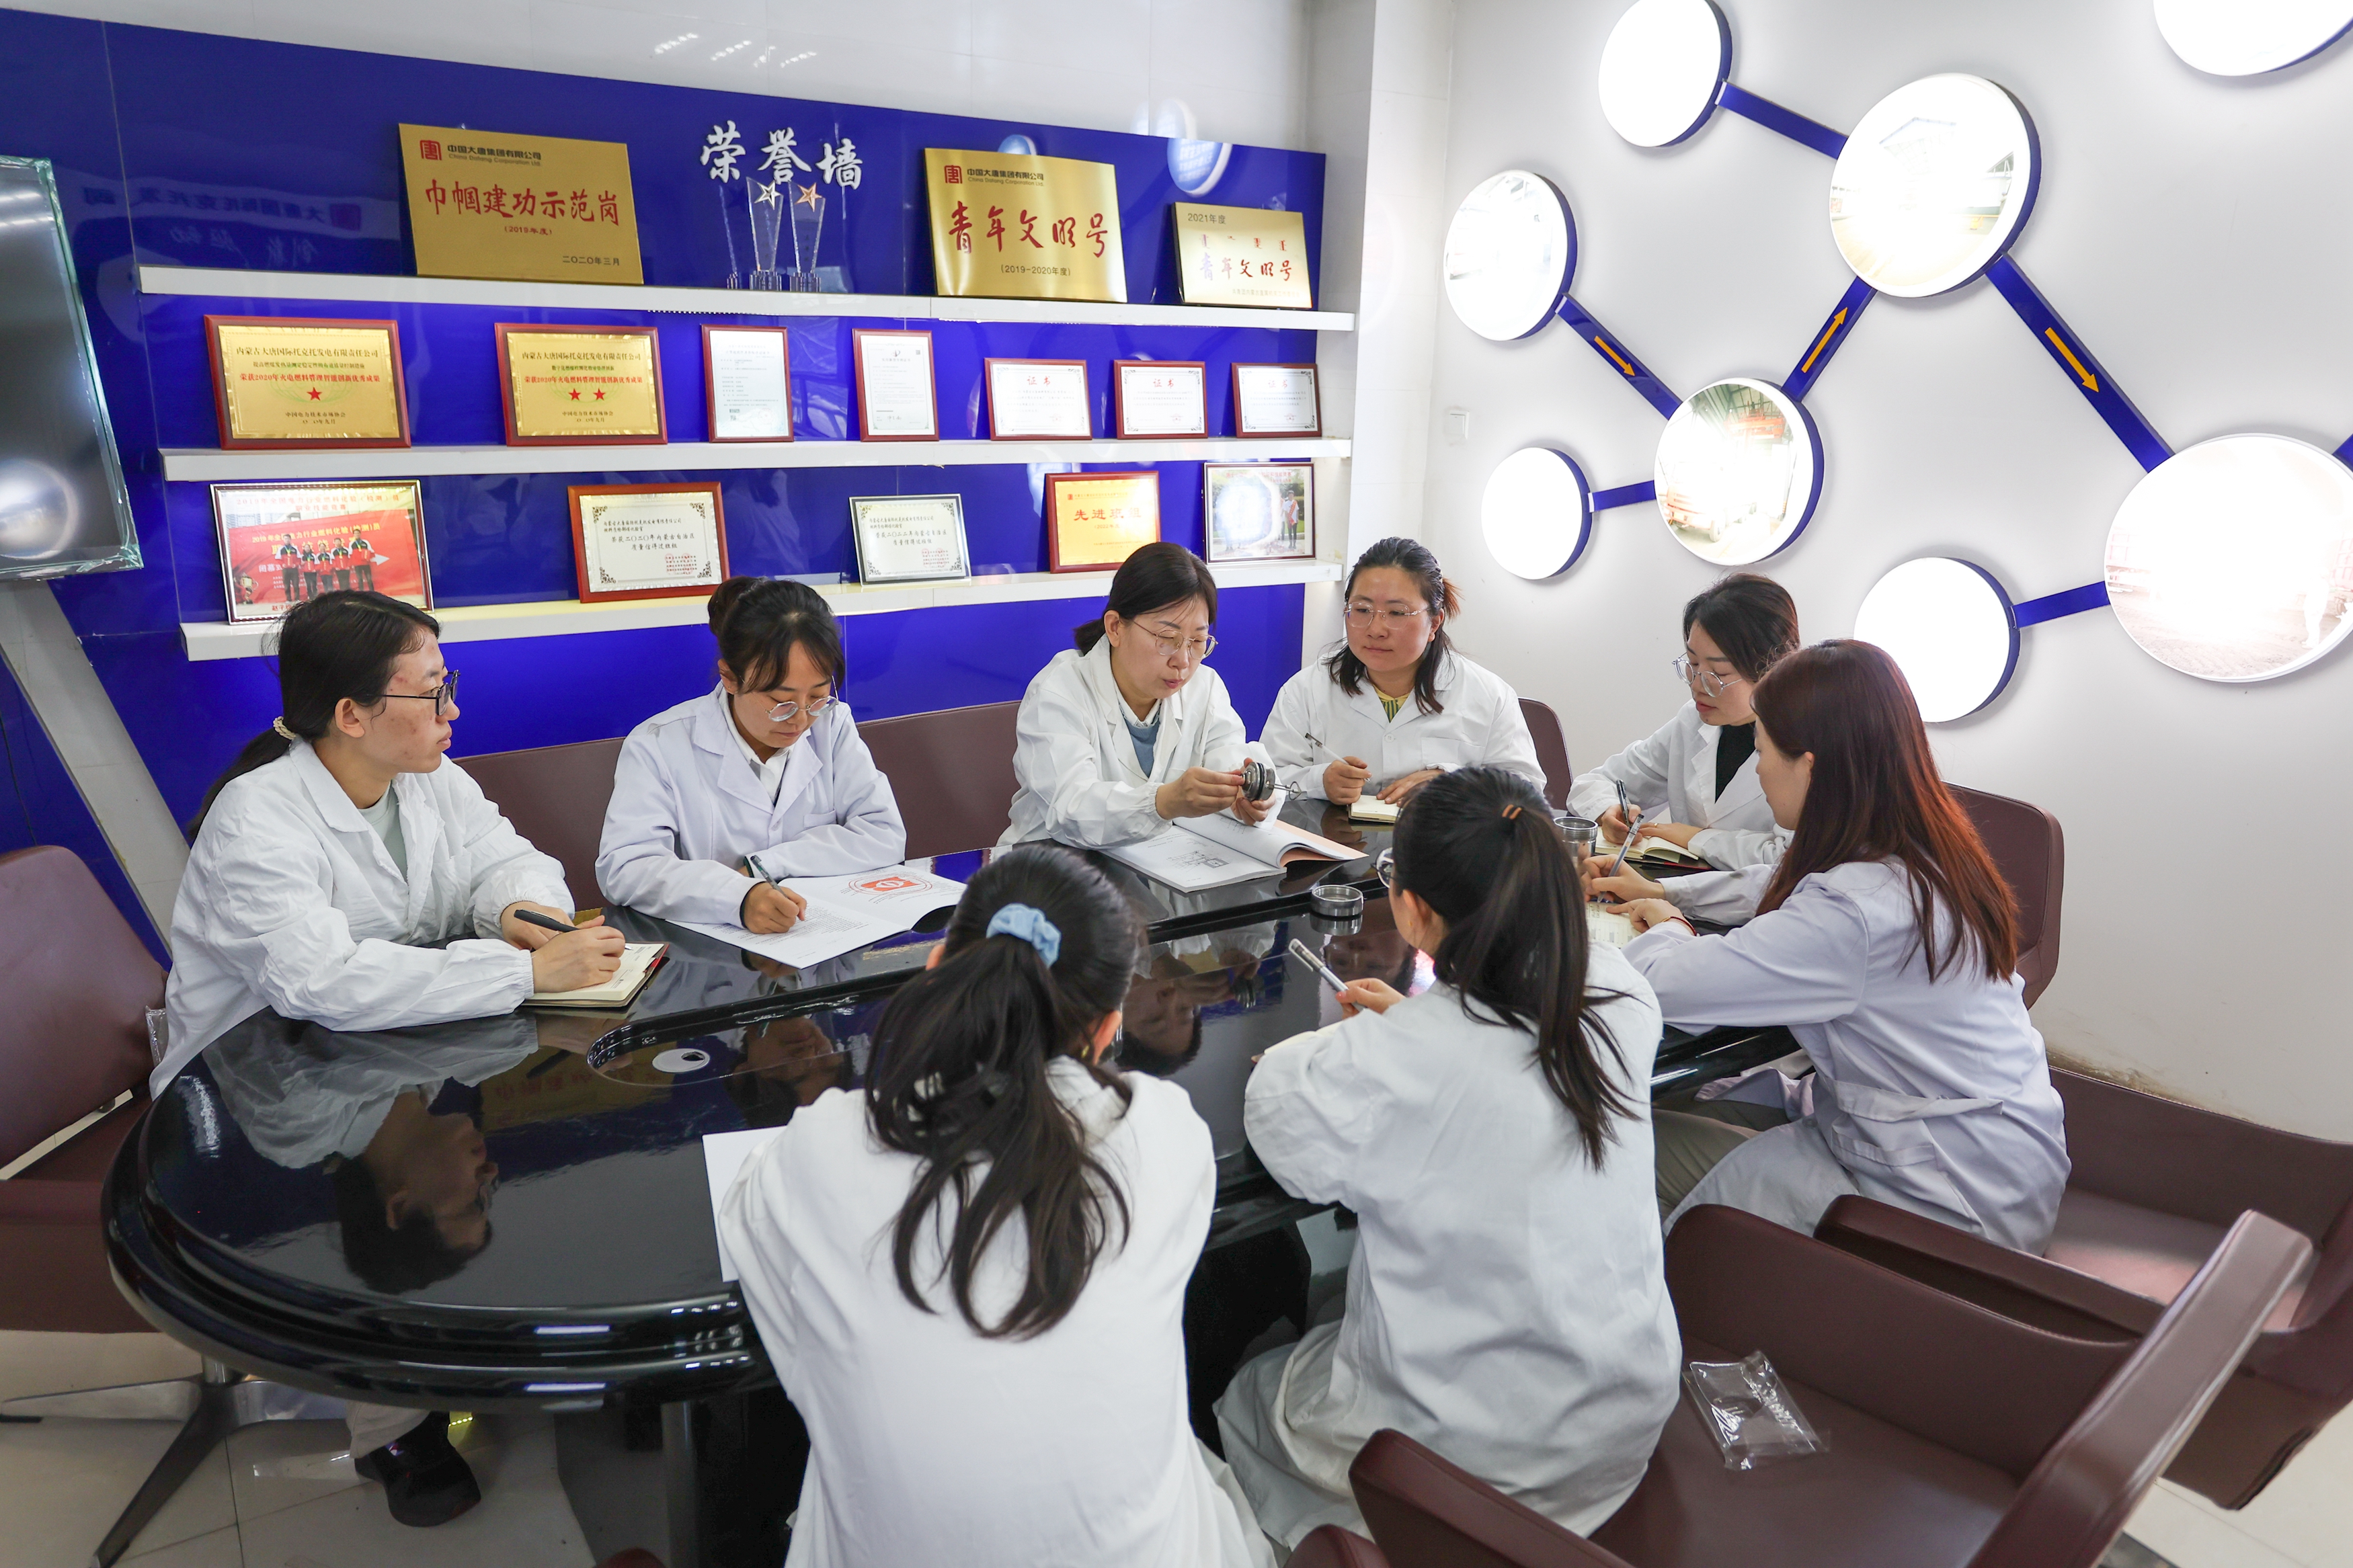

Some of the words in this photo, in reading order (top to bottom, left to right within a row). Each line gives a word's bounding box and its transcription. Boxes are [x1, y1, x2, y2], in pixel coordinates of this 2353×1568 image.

[447, 144, 541, 160] 中国大唐集团有限公司
[700, 120, 863, 190] 荣誉墙
[967, 168, 1044, 181] 中国大唐集团有限公司
[425, 179, 620, 226] 巾帼建功示范岗
[1187, 212, 1226, 224] 2021年度
[949, 200, 1108, 258] 青年文明号
[1200, 252, 1292, 282] 青年文明号
[1027, 376, 1051, 387] 证书
[1152, 378, 1174, 388] 证书
[1074, 507, 1142, 521] 先进班组
